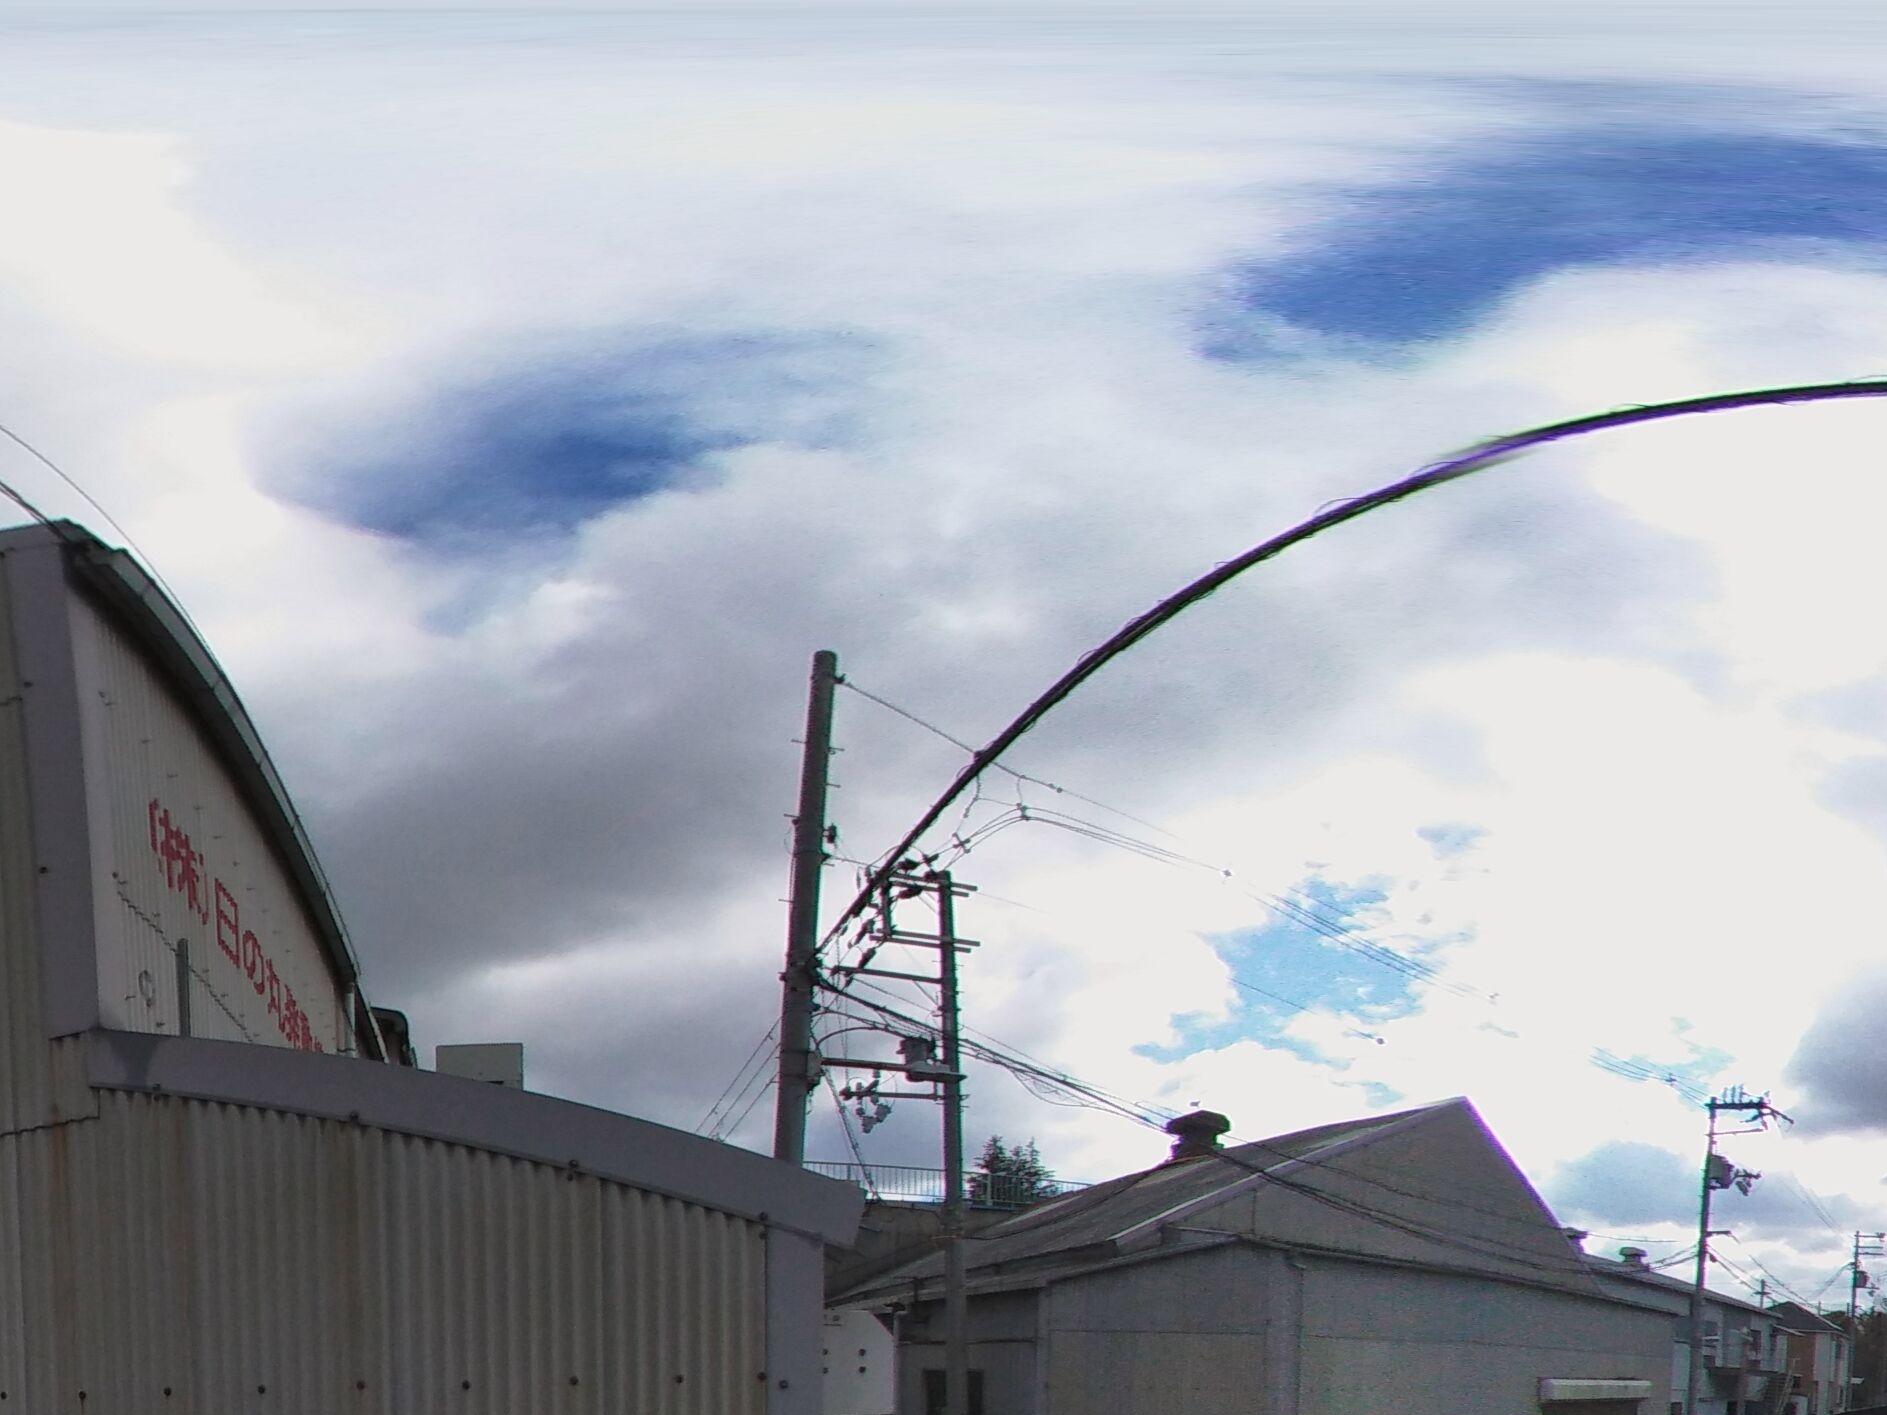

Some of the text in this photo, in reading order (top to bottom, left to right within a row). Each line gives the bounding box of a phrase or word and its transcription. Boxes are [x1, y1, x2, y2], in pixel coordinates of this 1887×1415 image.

[148, 798, 324, 1053] (株)日の丸発動
